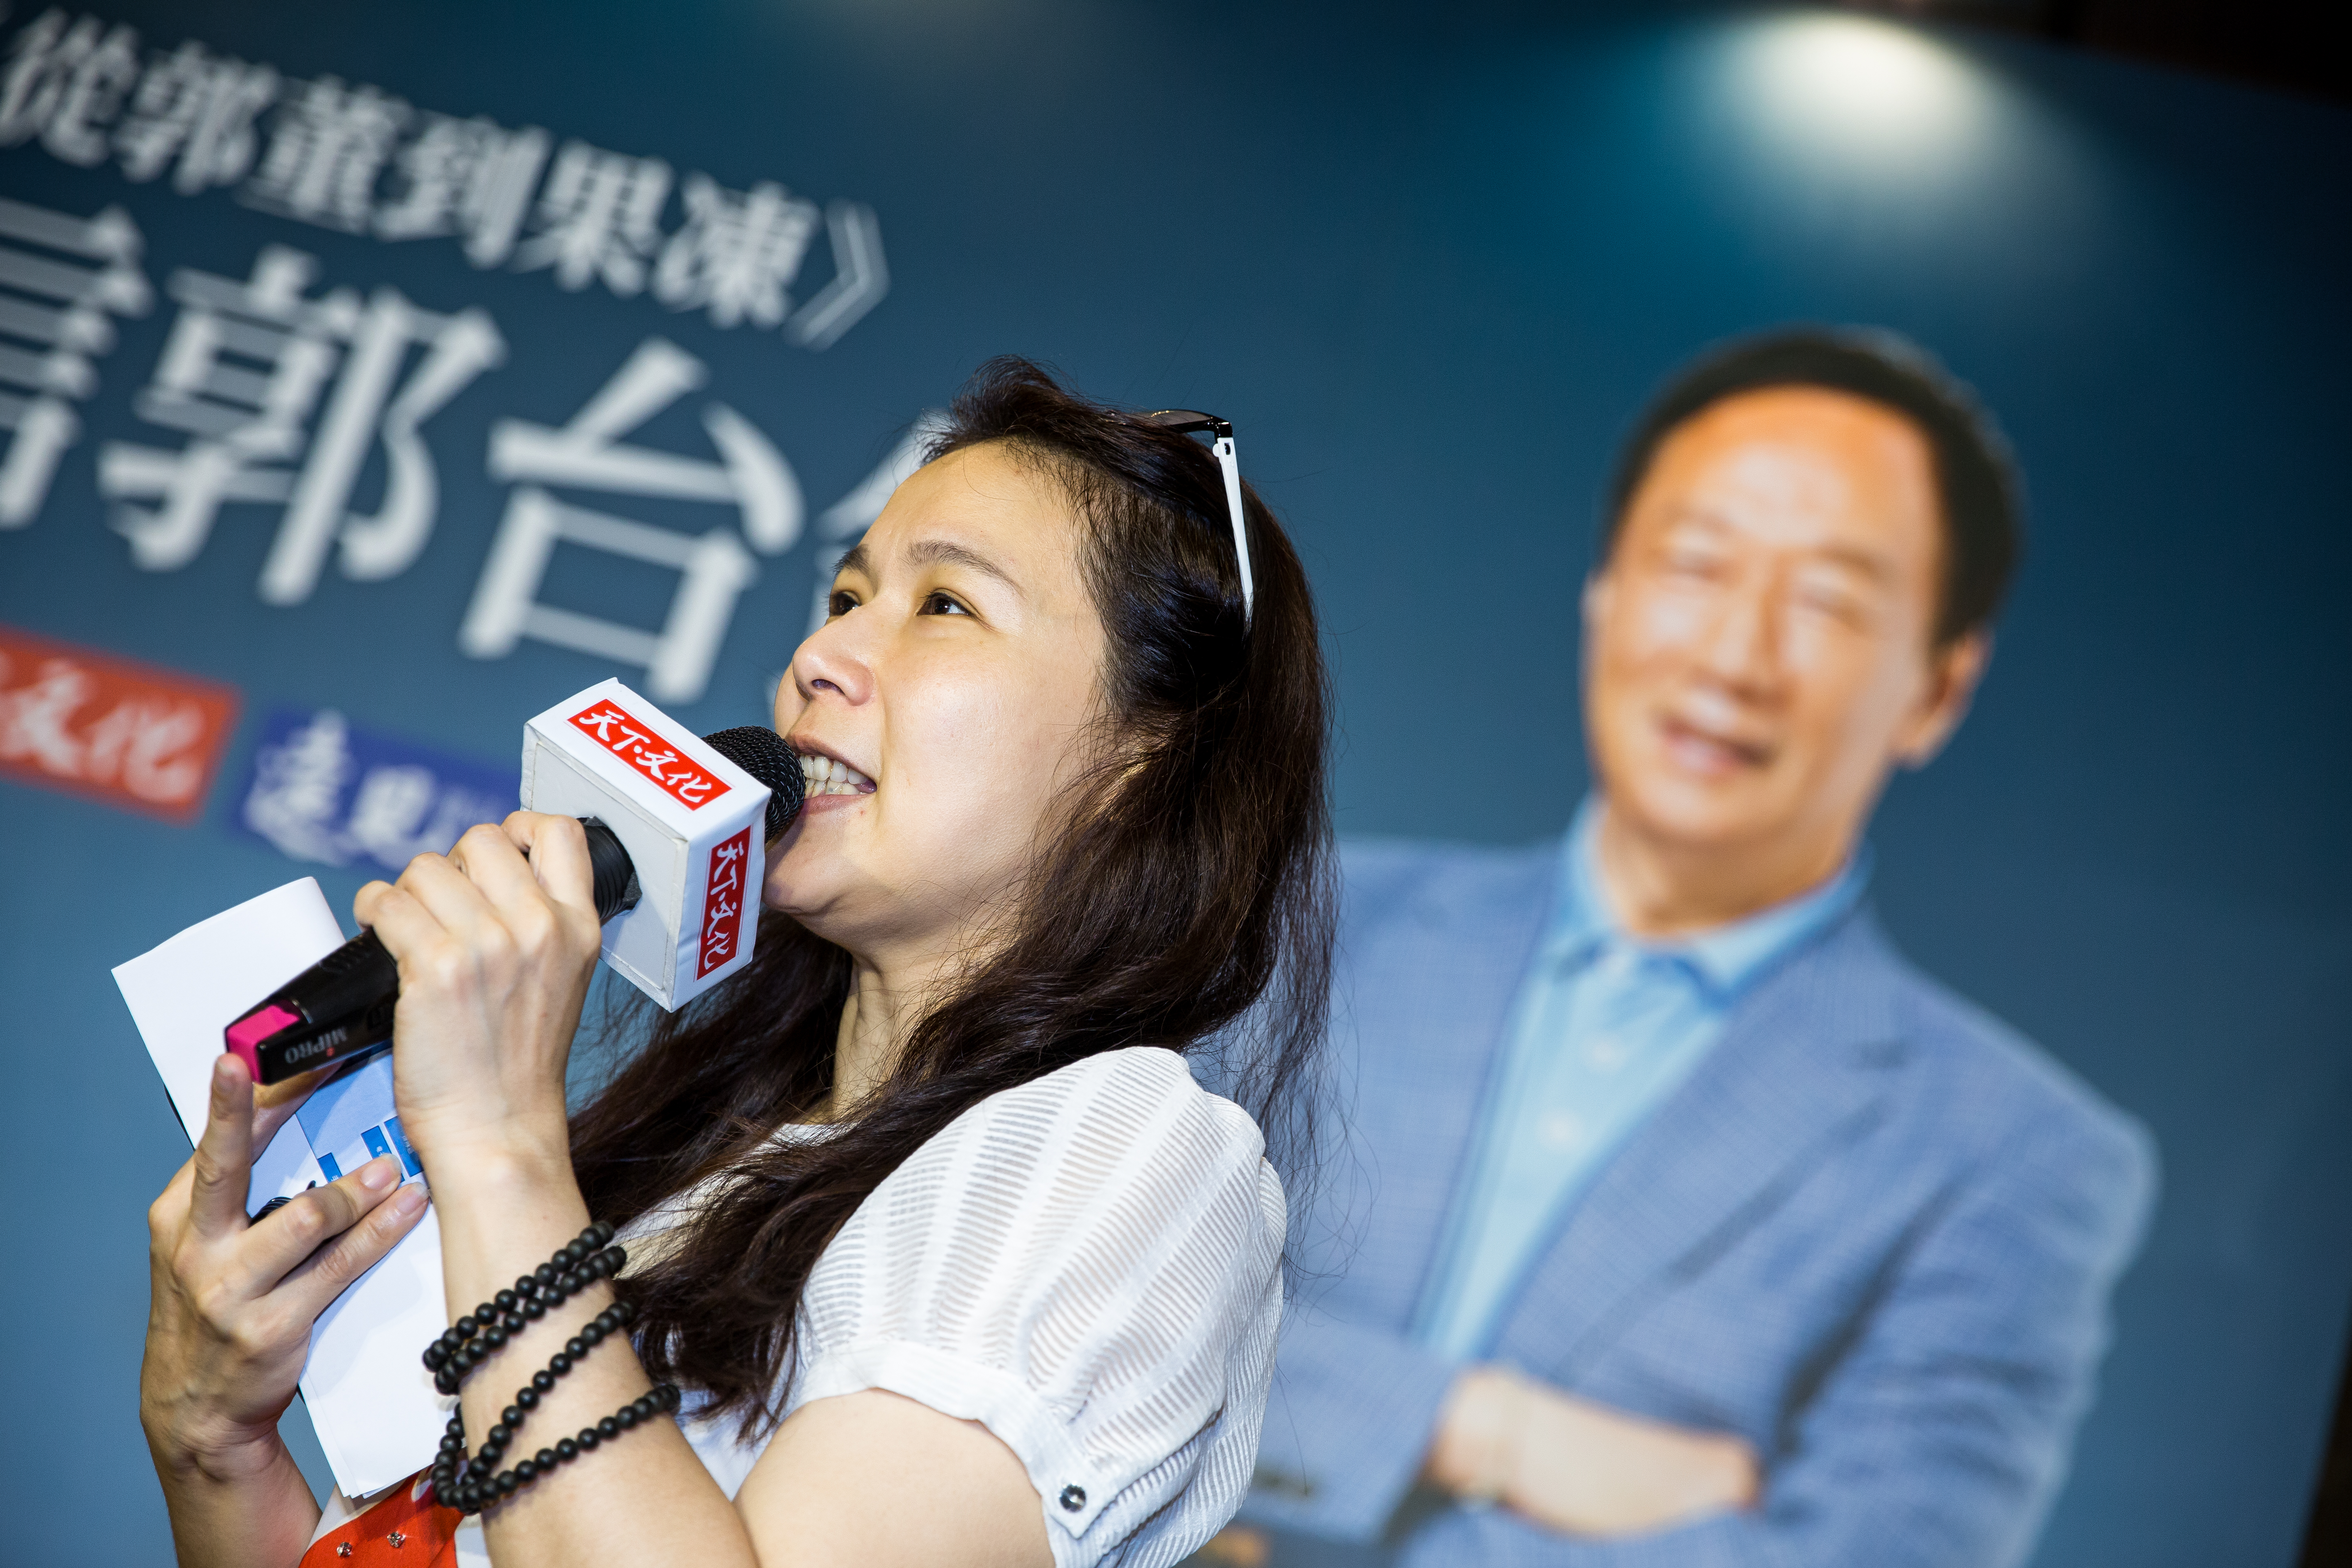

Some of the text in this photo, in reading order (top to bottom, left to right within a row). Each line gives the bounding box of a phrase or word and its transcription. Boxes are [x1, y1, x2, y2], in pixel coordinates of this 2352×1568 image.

[0, 204, 951, 706] 郭台
[579, 709, 712, 803] 天下文化
[704, 841, 744, 970] 天下文化
[285, 1026, 347, 1064] MiPRO
